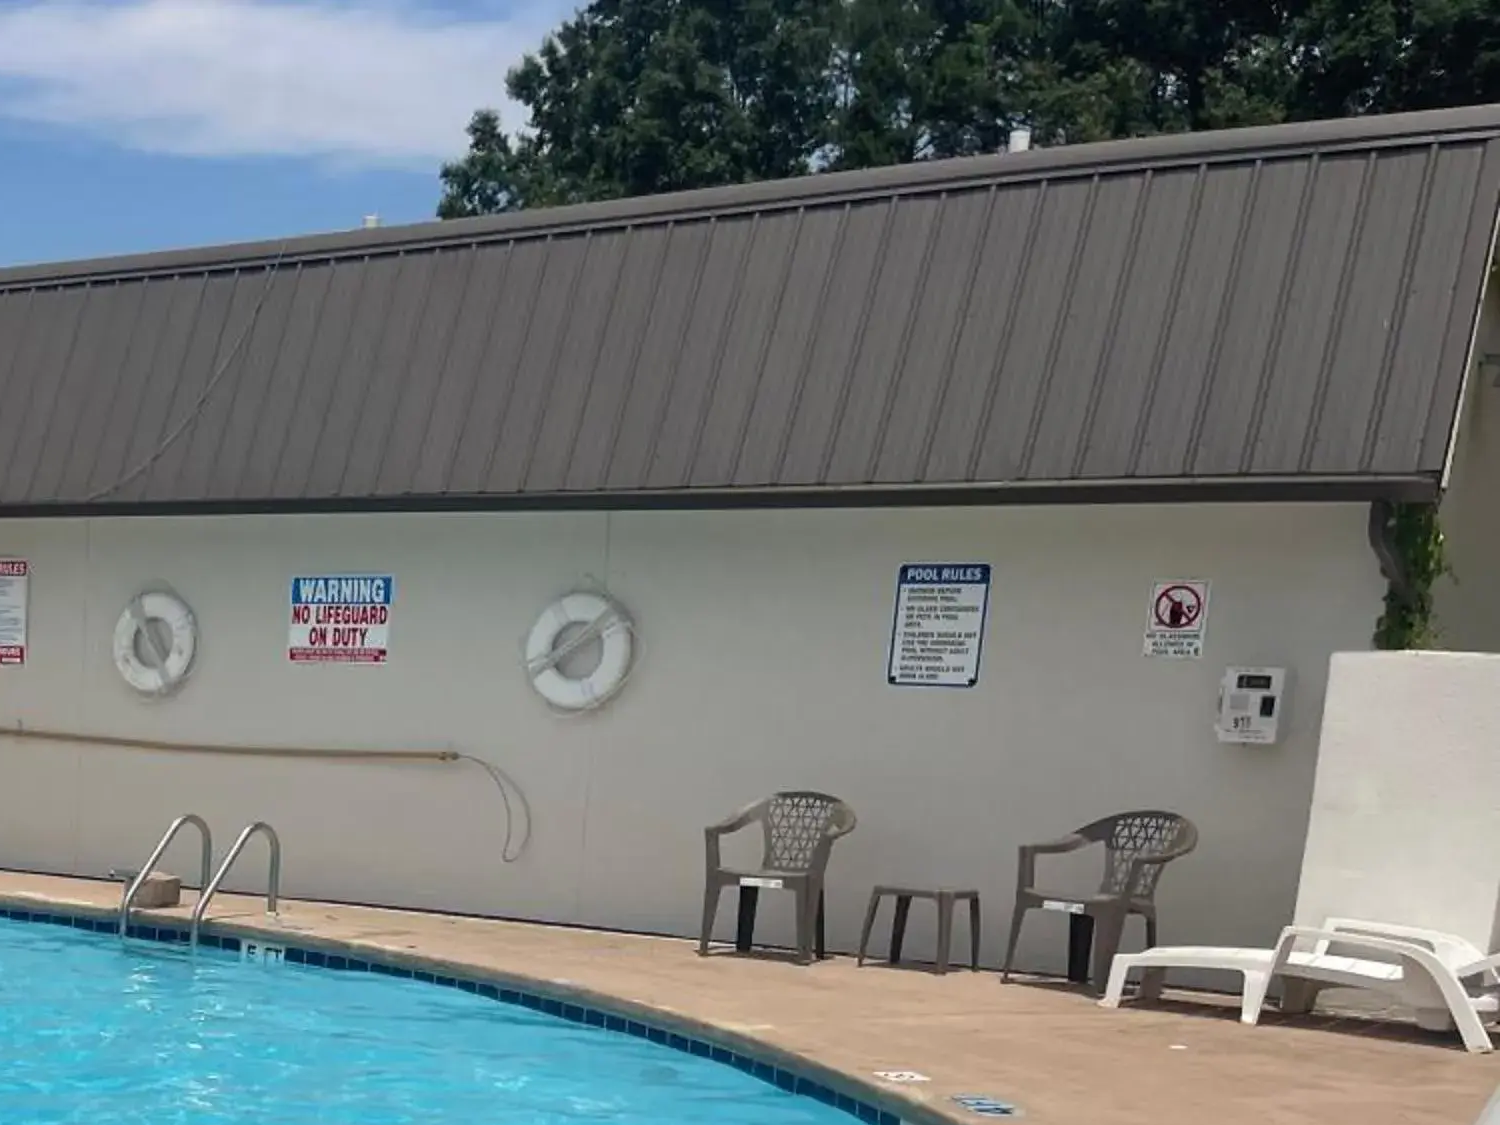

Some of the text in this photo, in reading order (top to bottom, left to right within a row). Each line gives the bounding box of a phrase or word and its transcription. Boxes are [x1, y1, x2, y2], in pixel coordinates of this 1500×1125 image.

[907, 567, 983, 581] POOL RULES
[299, 579, 385, 603] WARNING
[292, 606, 388, 625] NO LIFEGUARD
[309, 627, 369, 647] ON DUTY
